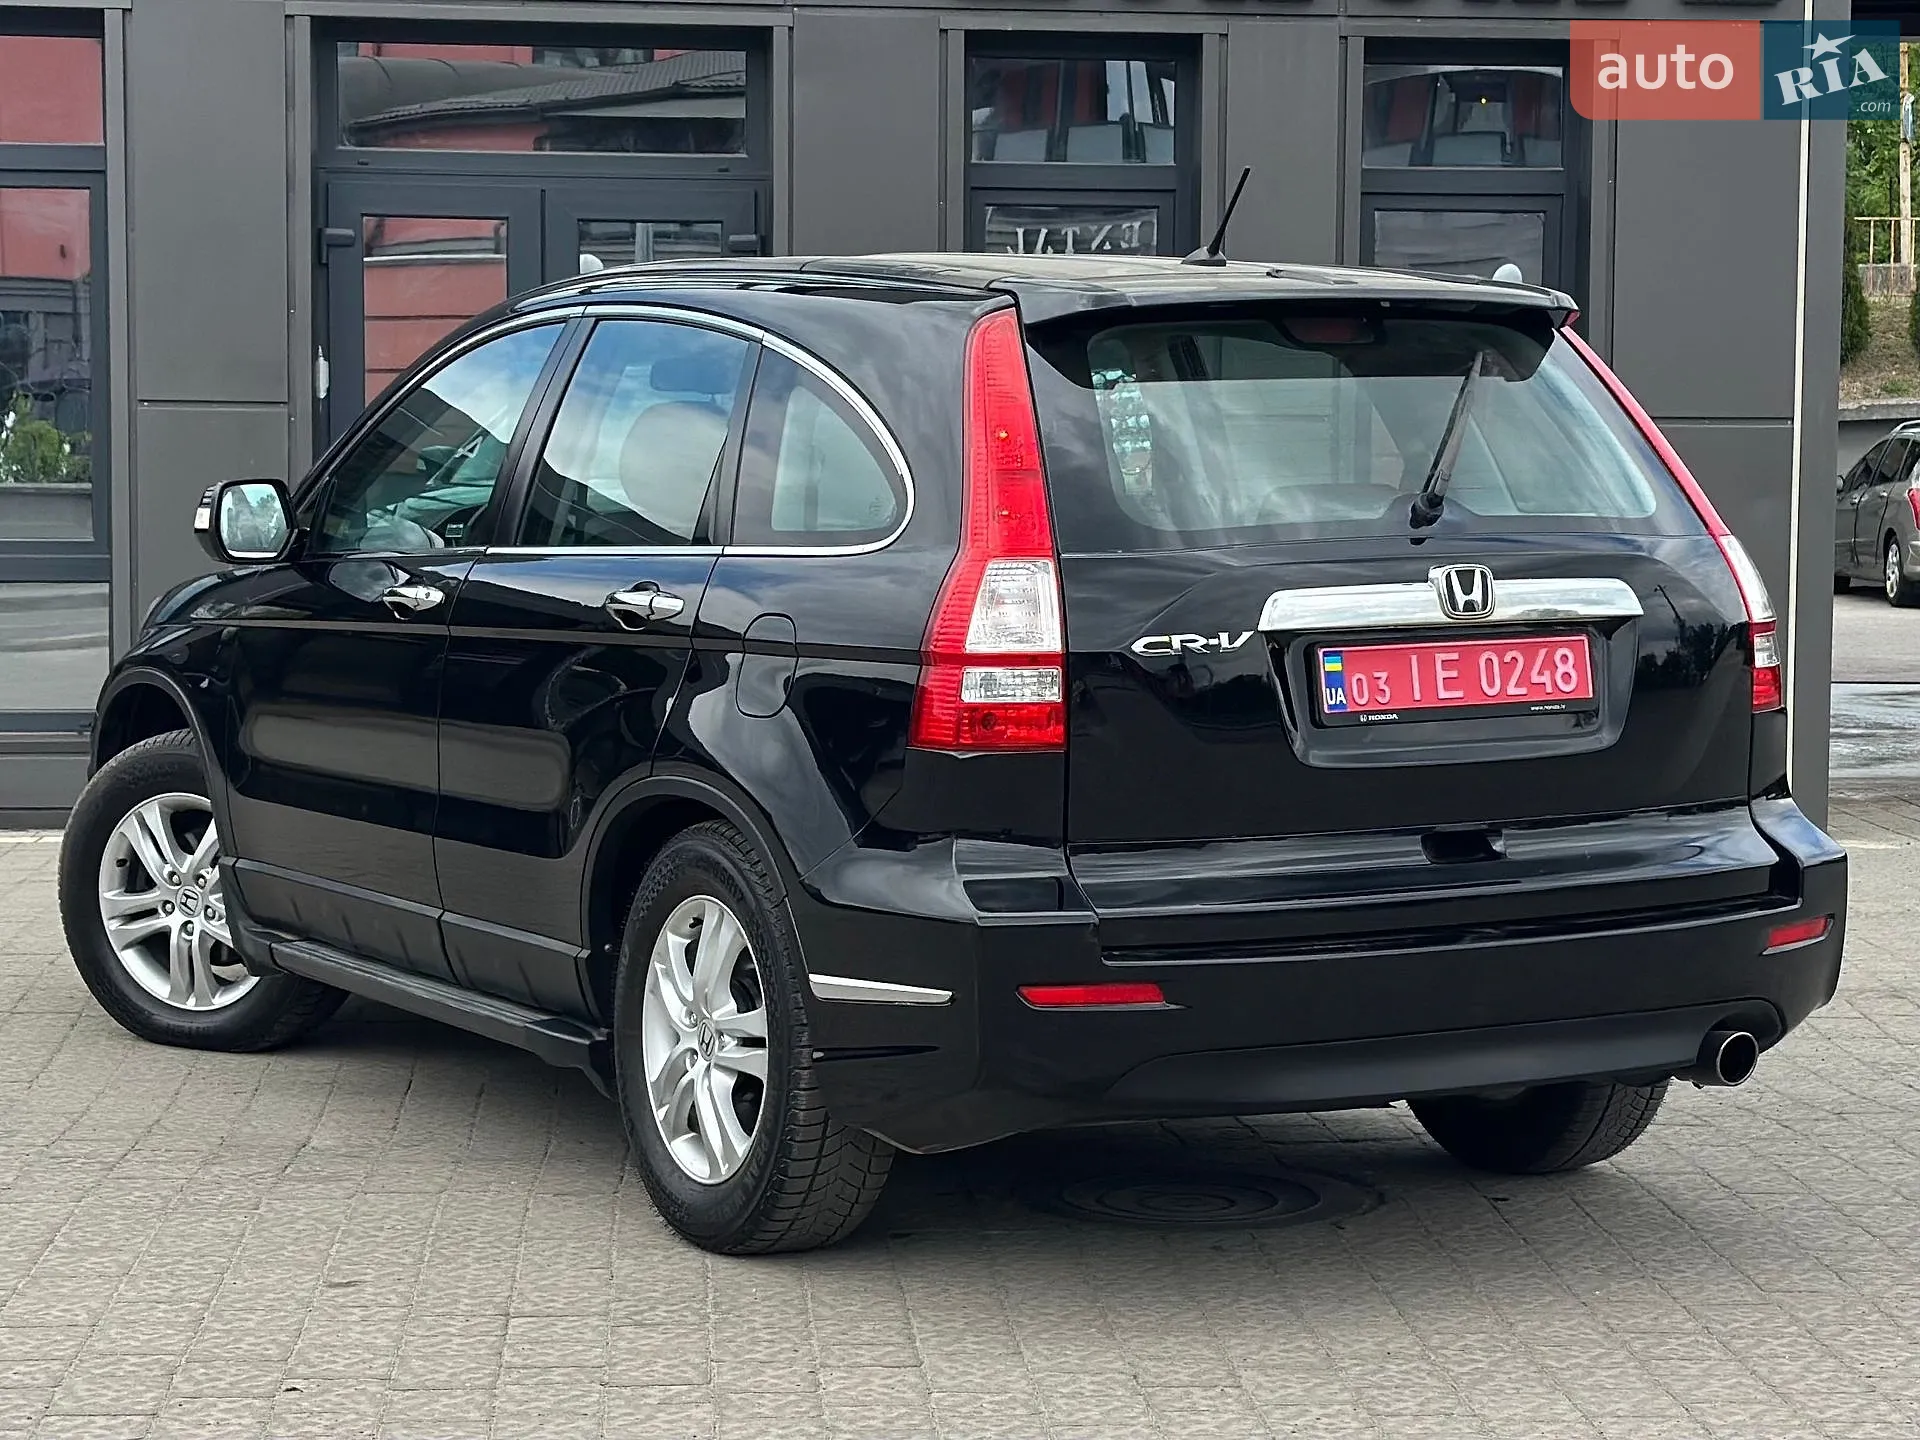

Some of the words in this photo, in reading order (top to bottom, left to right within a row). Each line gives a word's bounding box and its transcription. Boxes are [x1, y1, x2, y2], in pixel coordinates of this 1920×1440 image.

[1130, 630, 1255, 656] CR-V
[1351, 671, 1392, 706] 03
[1409, 651, 1465, 701] IE
[1478, 646, 1578, 698] 0248
[1325, 687, 1347, 705] UA
